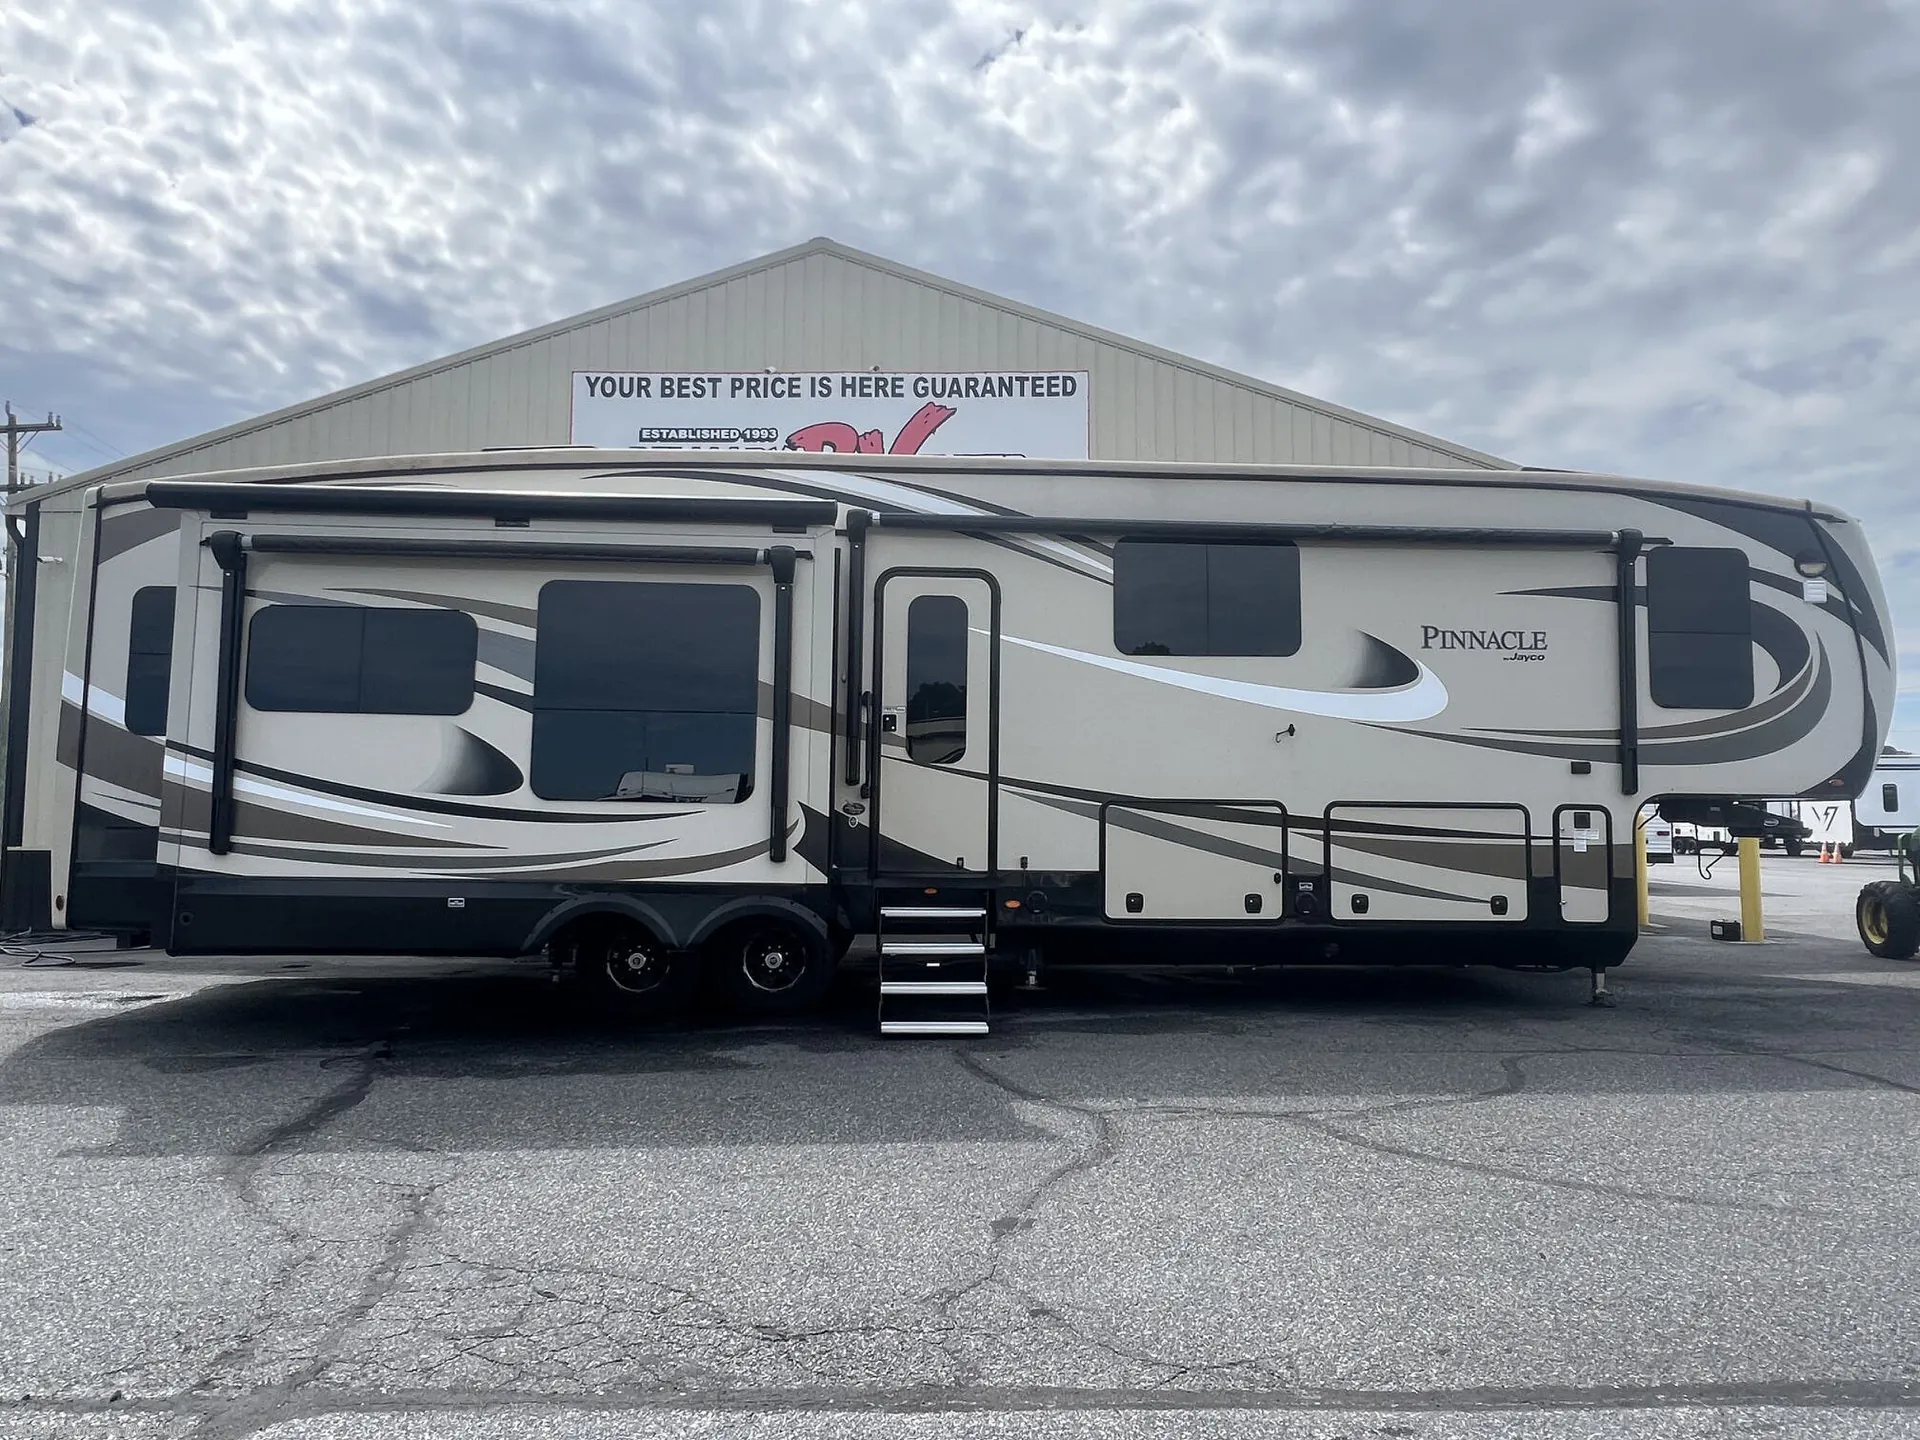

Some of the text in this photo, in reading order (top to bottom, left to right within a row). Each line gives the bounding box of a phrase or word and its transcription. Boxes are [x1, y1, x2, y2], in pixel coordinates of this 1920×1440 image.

[585, 375, 1077, 399] YOUR BEST PRICE IS HERE GUARANTEED
[640, 428, 778, 442] ESTABLISHED 1993
[1421, 625, 1548, 650] PINNACLE
[1509, 652, 1545, 663] Jayco
